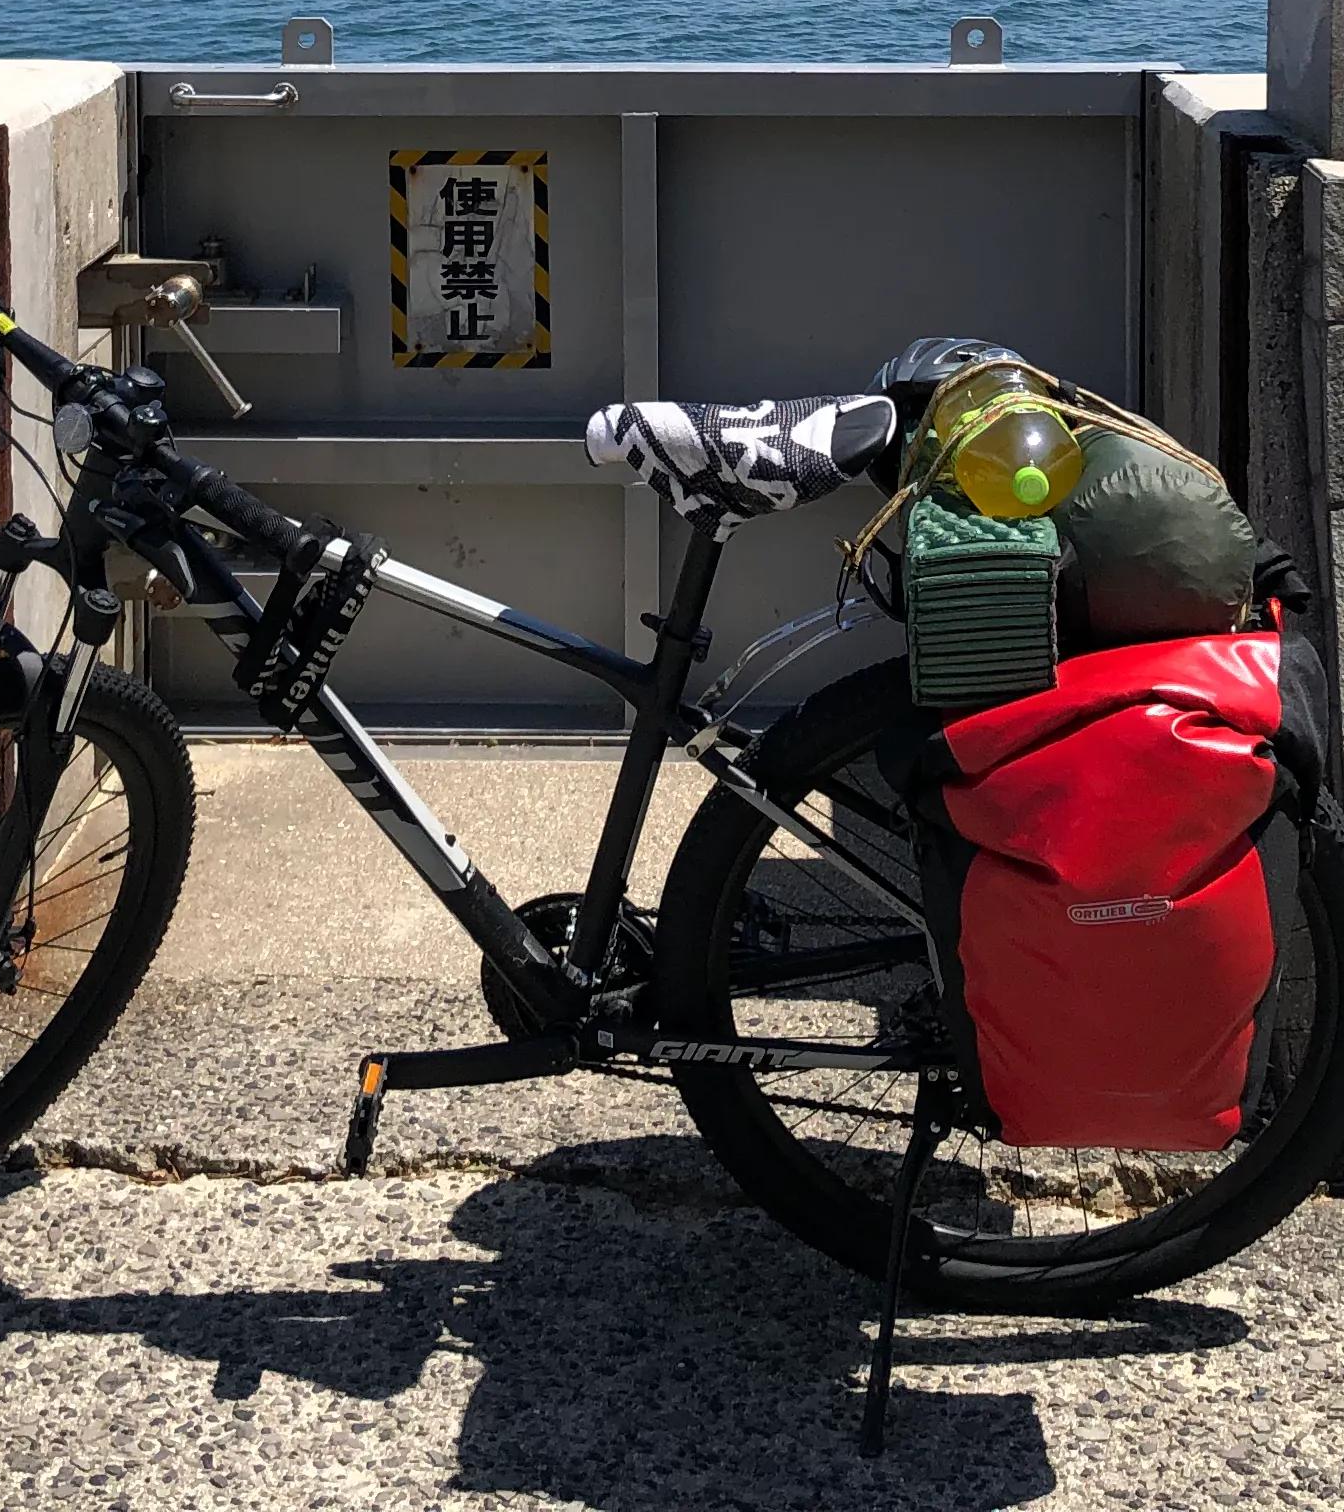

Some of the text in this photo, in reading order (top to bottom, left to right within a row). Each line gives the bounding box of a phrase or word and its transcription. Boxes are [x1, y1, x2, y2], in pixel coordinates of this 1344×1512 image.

[439, 177, 499, 341] 使用禁止
[1073, 907, 1127, 919] ORTLIEB
[649, 1040, 802, 1066] GIANT
